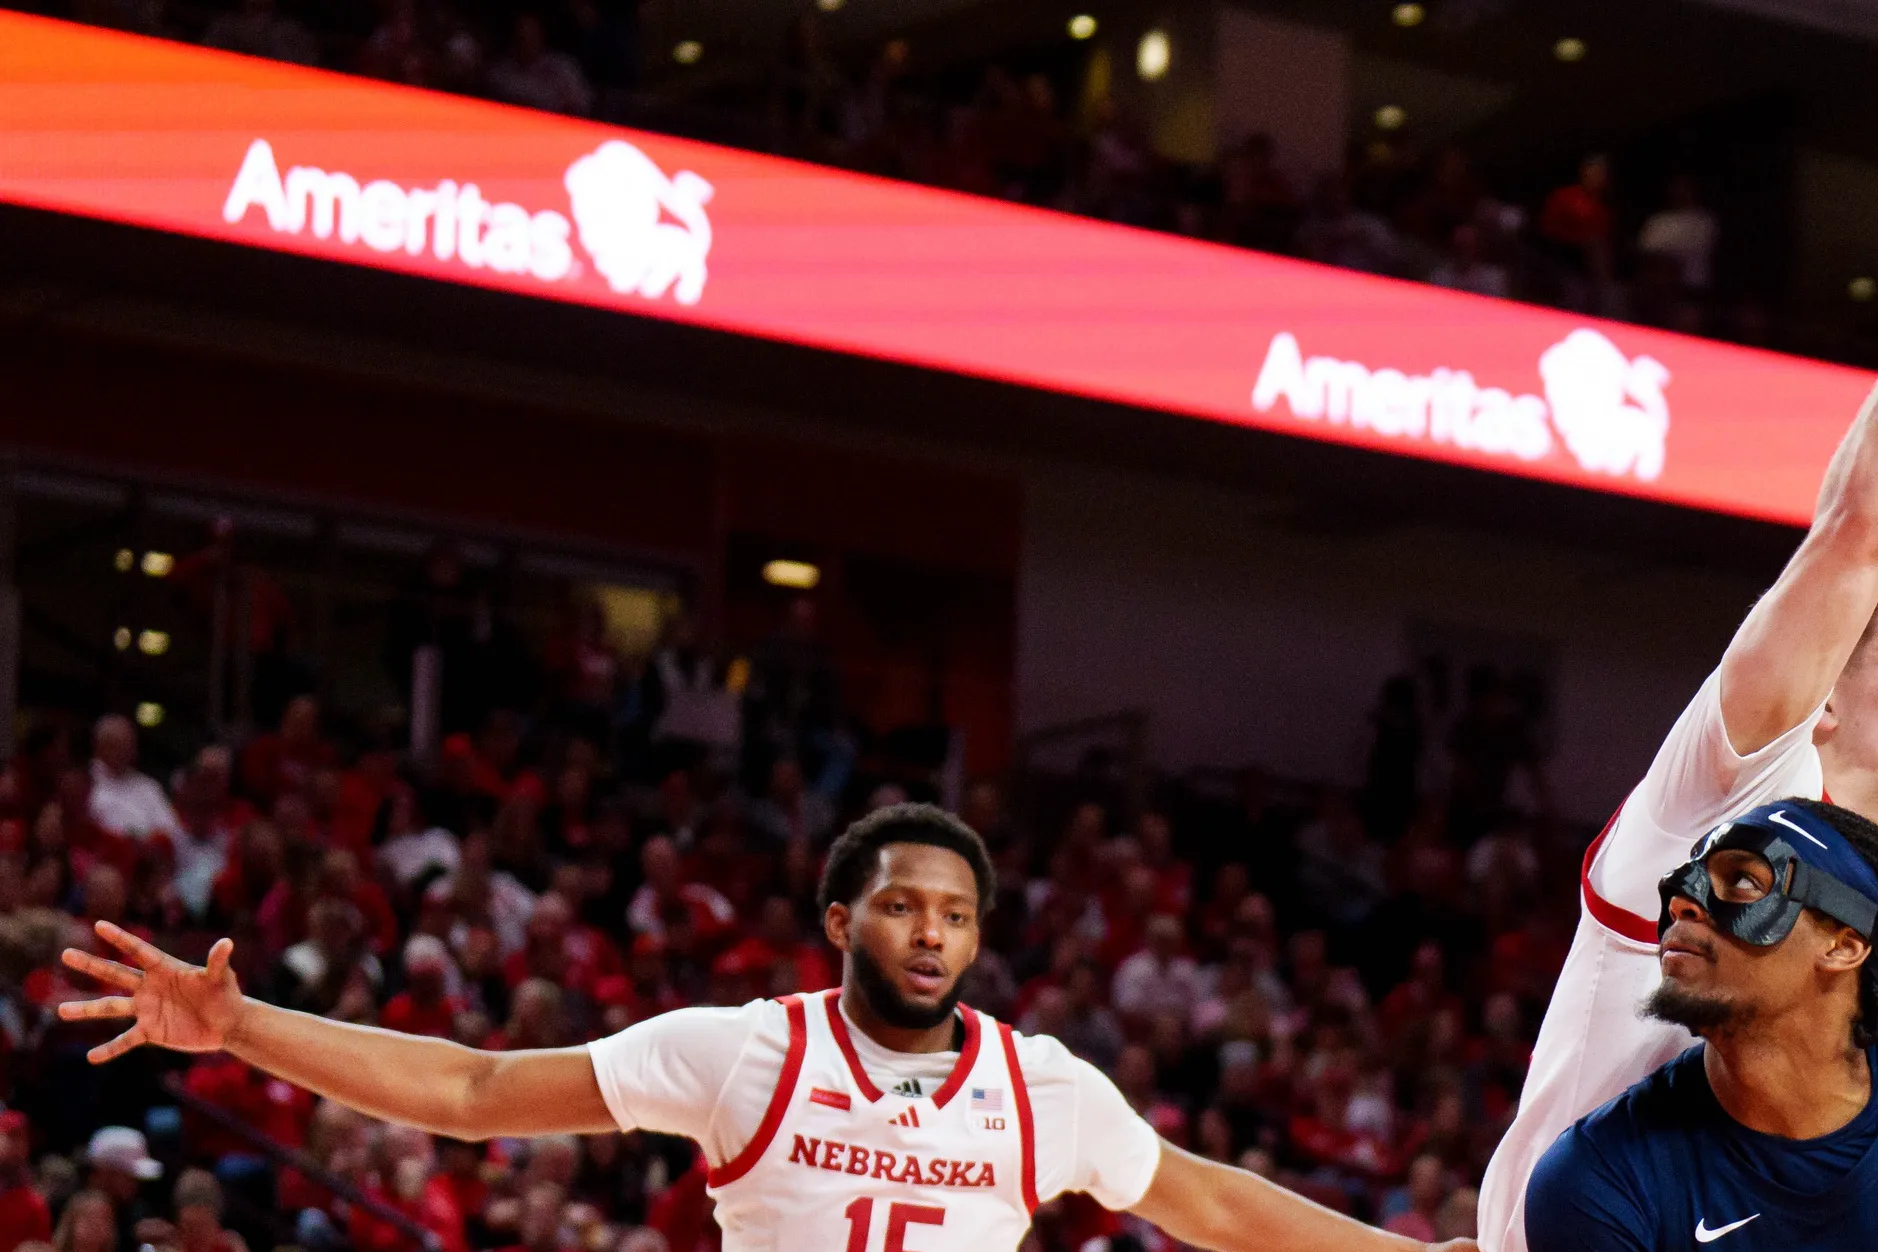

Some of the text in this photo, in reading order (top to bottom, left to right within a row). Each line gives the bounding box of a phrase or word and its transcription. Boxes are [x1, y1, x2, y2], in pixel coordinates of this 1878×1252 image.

[222, 138, 574, 282] Ameritas
[1251, 331, 1552, 460] Ameritas
[788, 1133, 997, 1188] NEBRASKA
